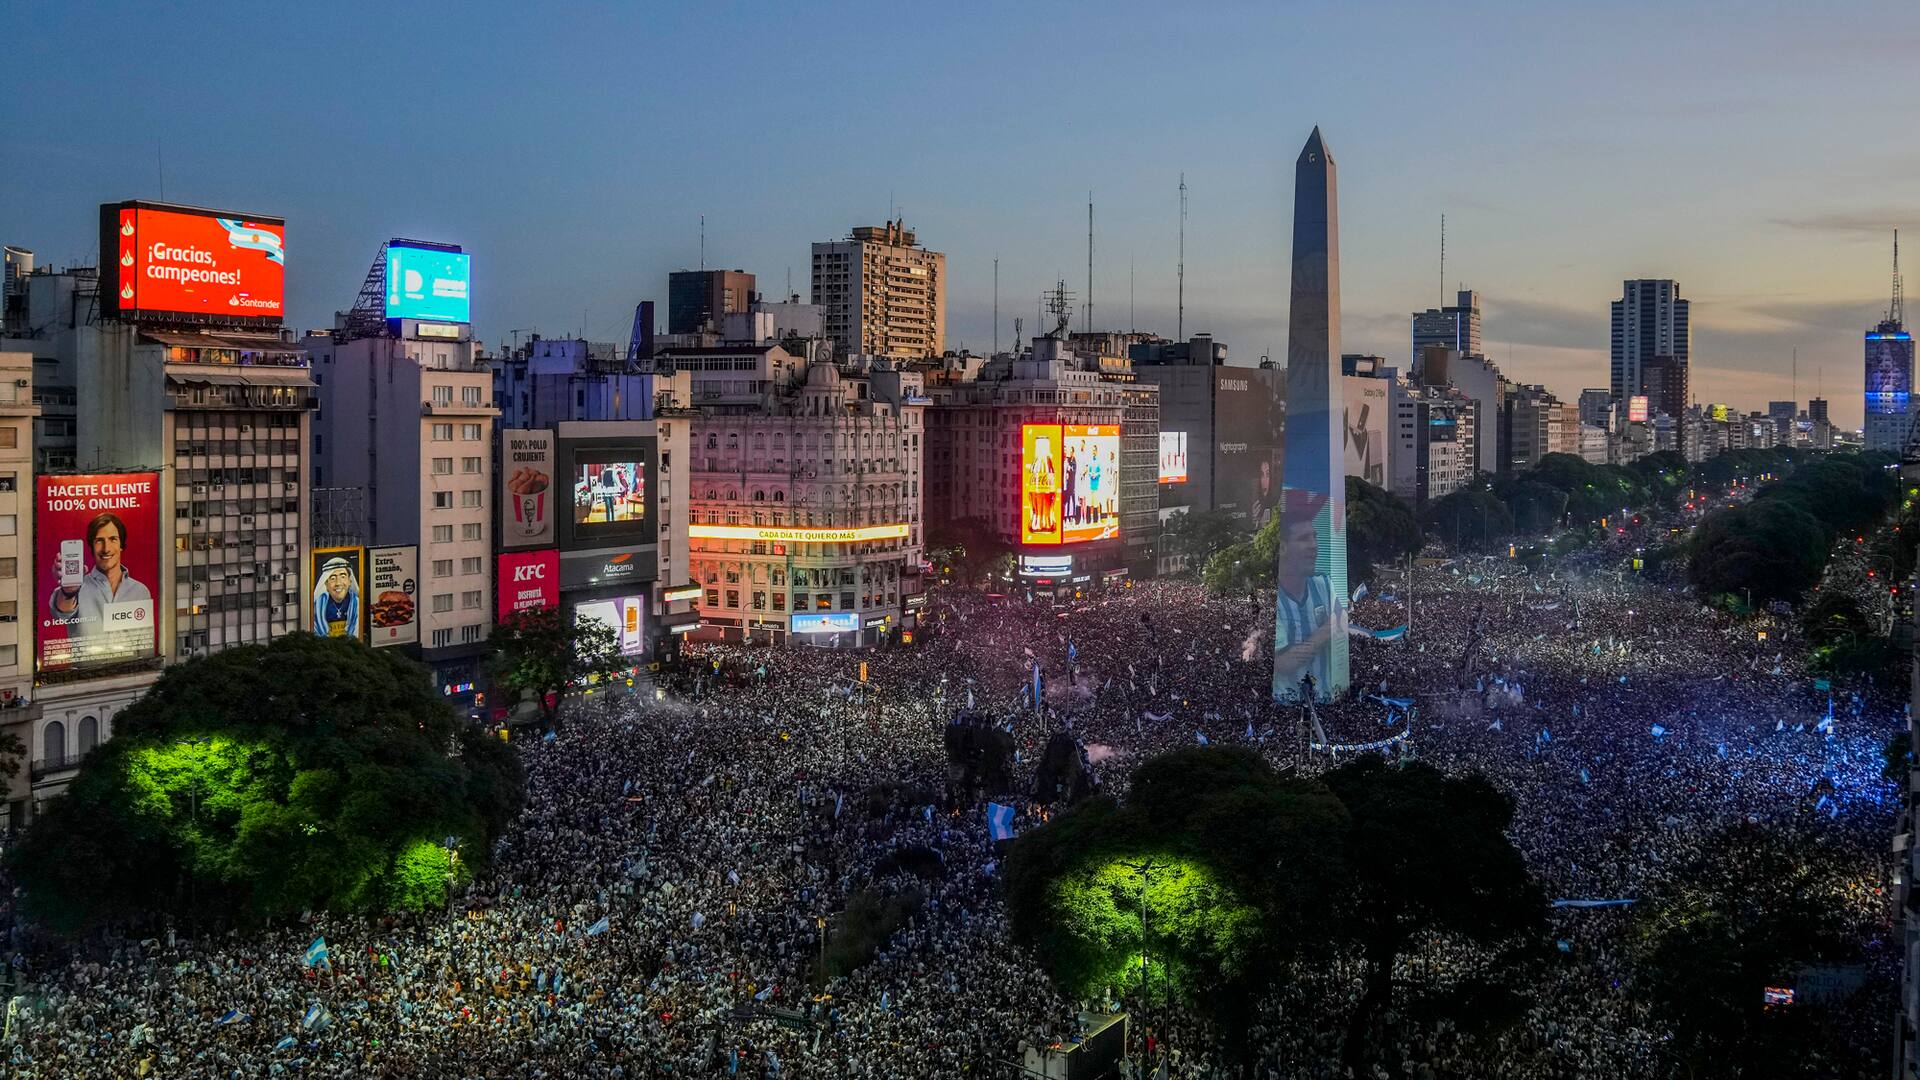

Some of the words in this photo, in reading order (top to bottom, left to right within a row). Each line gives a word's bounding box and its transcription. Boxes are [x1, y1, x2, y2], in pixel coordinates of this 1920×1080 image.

[147, 242, 217, 267] ¡Gracias,
[147, 265, 241, 285] campeones!
[239, 297, 280, 309] Santander
[1220, 378, 1248, 391] SAMSUNG
[510, 440, 528, 450] 100%
[528, 439, 548, 450] POLLO
[512, 451, 545, 462] CRUJIENTE
[47, 484, 98, 497] HACETE
[100, 482, 151, 495] CLIENTE
[47, 499, 86, 512] 100%
[88, 496, 140, 510] ONLINE.
[759, 530, 779, 539] CADA
[795, 532, 802, 540] TE
[805, 532, 838, 541] QUIERO
[375, 558, 394, 566] Extra
[513, 563, 546, 582] KFC
[603, 563, 634, 573] Atacama
[375, 573, 394, 582] extra
[111, 611, 133, 621] ICBC
